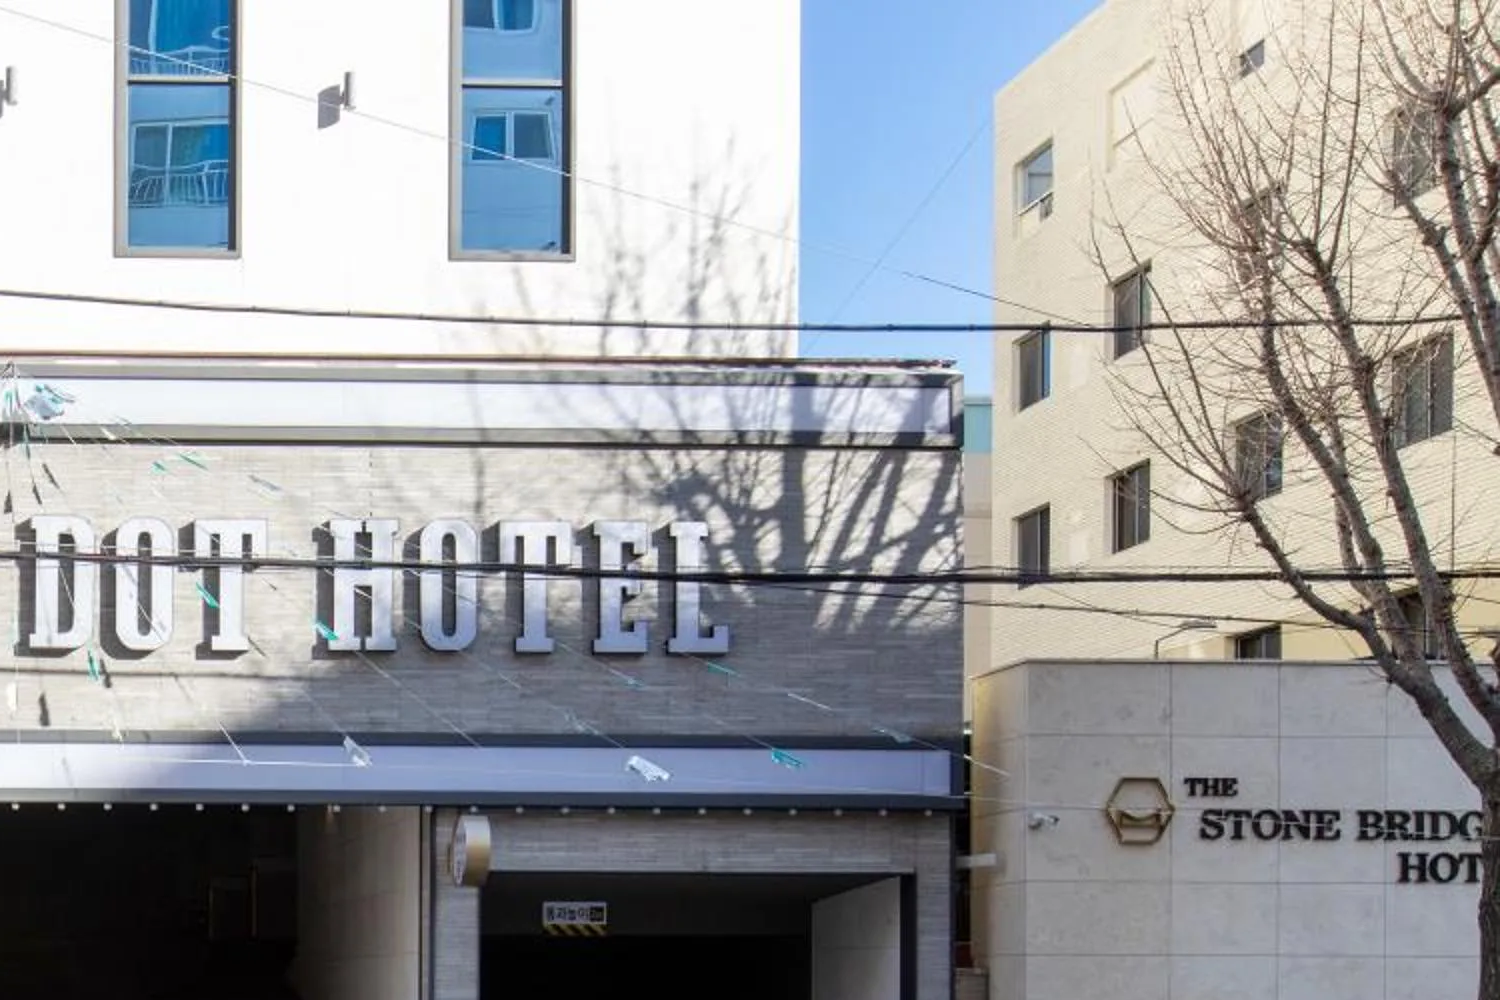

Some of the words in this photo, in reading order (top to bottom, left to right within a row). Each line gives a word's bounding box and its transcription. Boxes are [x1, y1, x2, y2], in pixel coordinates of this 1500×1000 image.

[26, 514, 270, 653] DOT
[324, 517, 731, 656] HOTEL
[1184, 776, 1239, 798] THE
[1199, 808, 1342, 842] STONE
